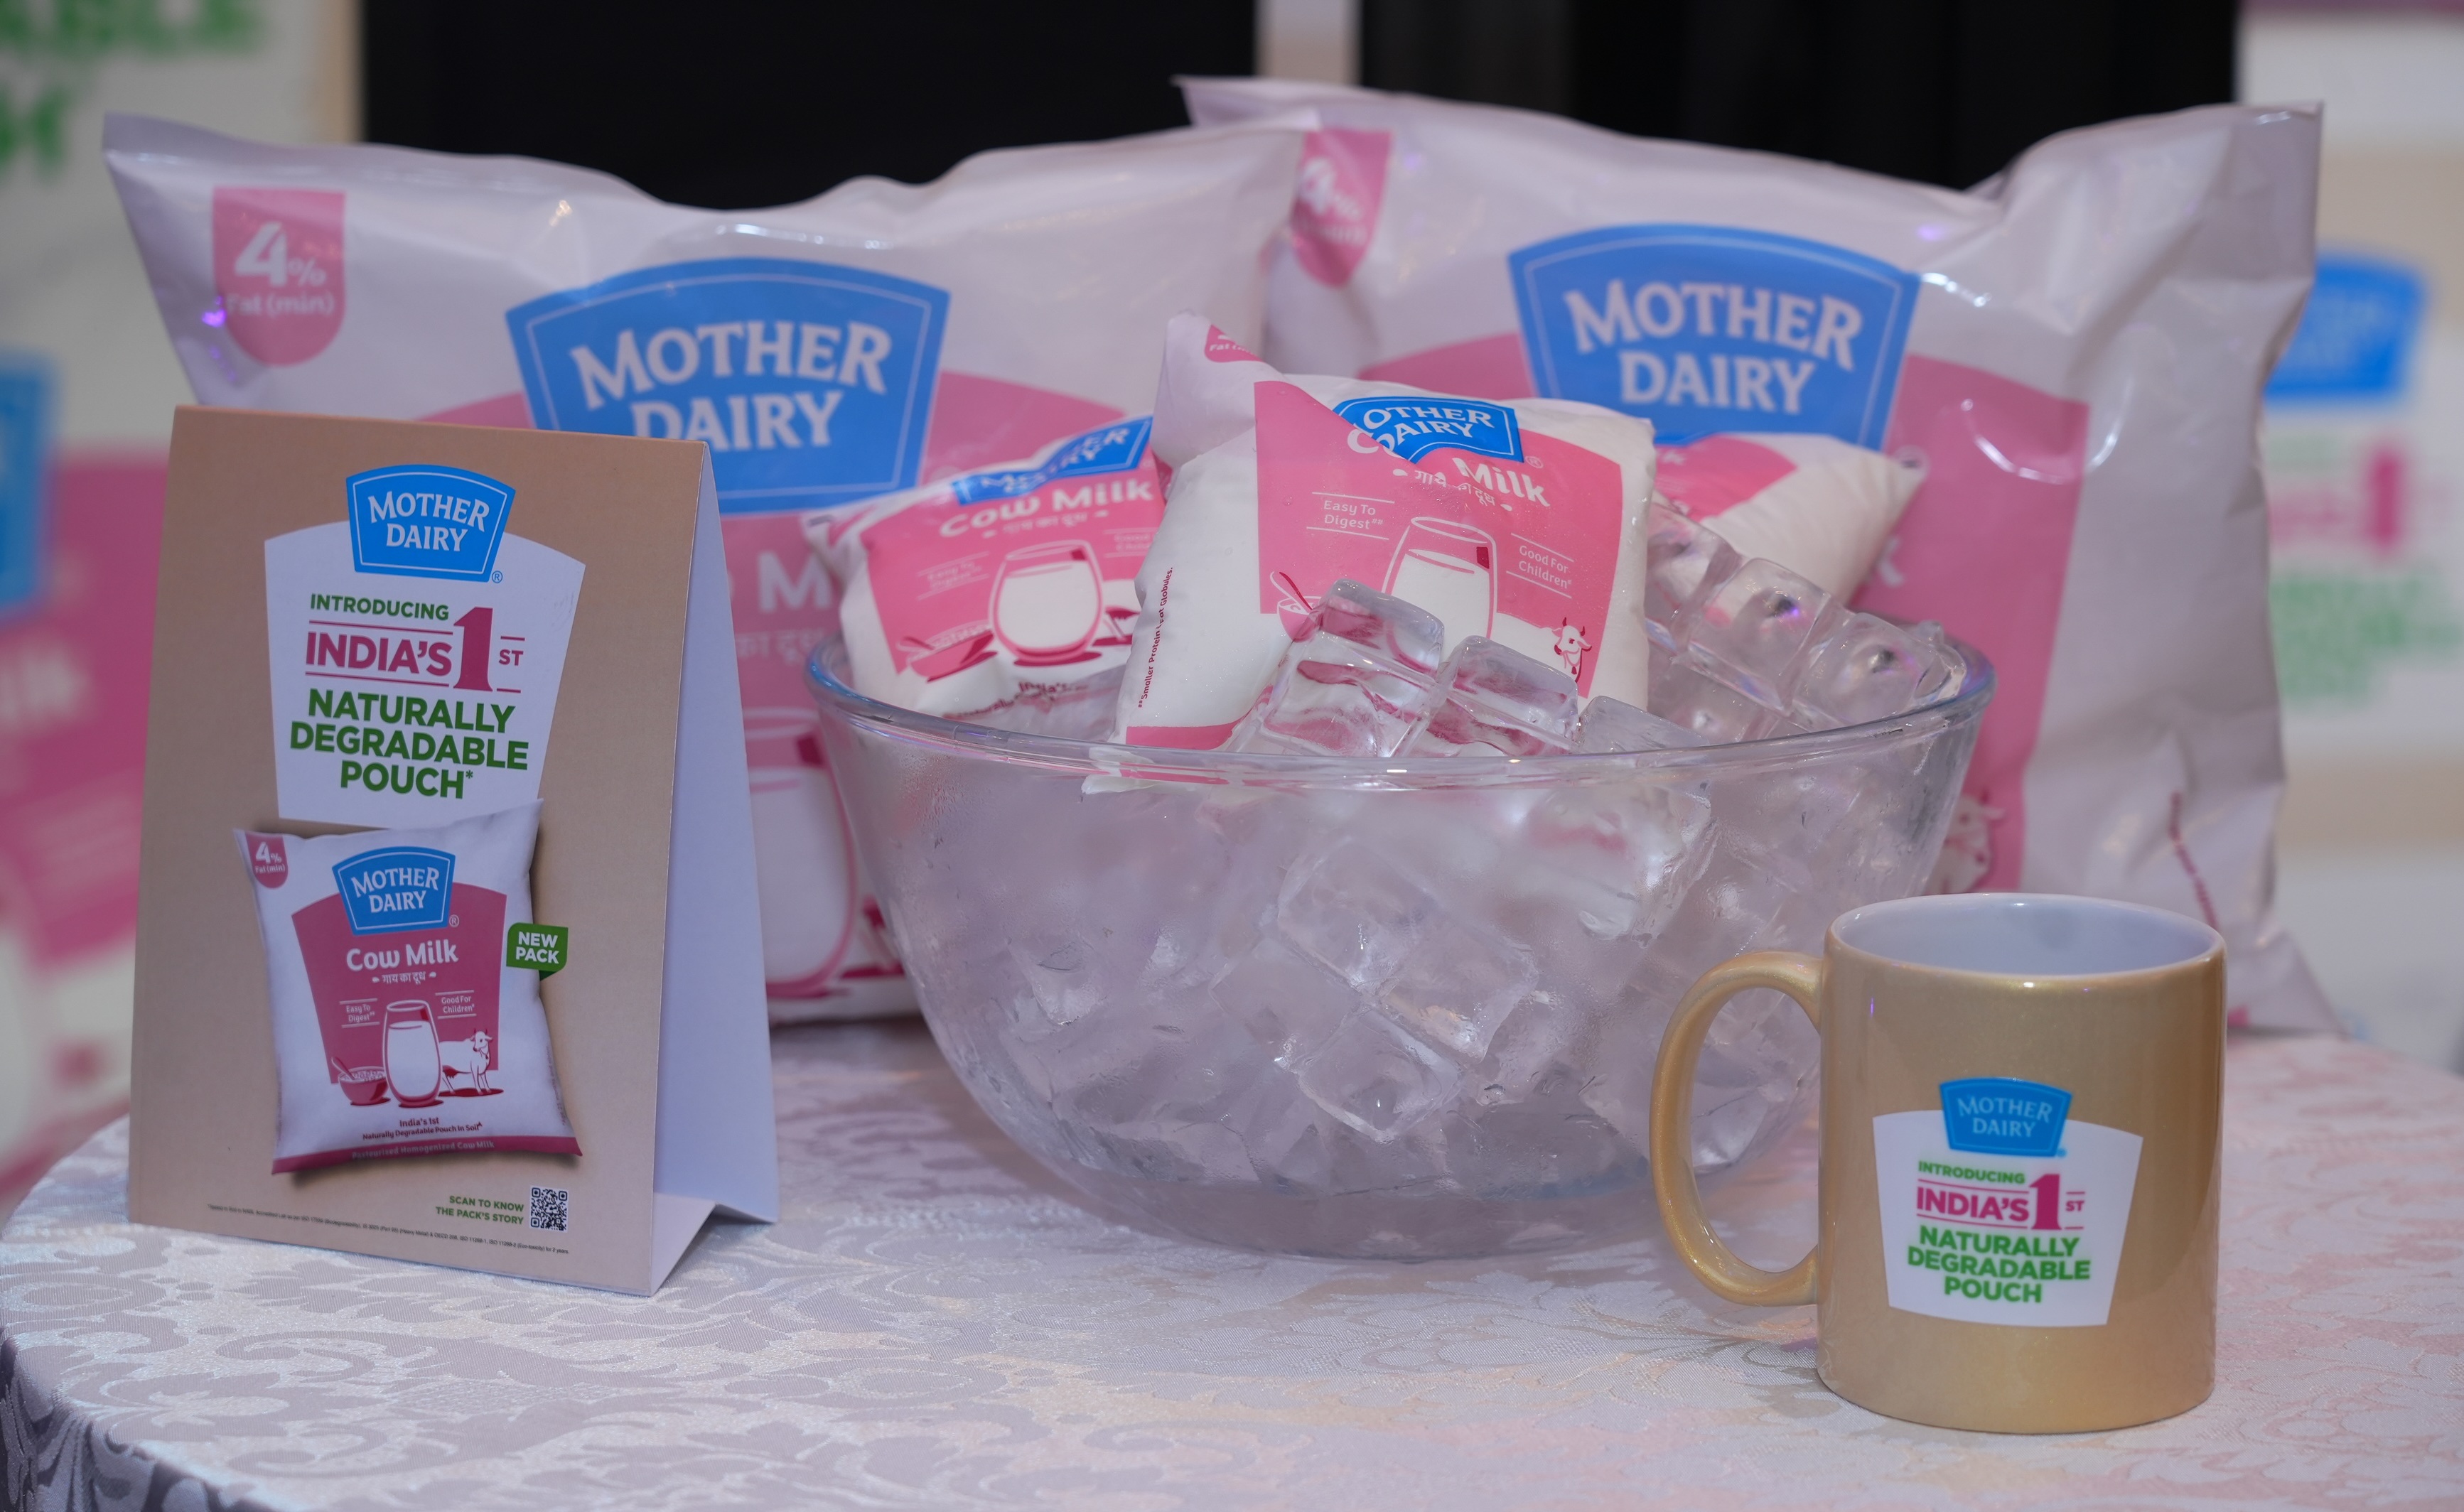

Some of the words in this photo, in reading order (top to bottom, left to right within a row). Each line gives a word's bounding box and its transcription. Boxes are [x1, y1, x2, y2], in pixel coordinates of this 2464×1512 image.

[234, 222, 327, 287] 4%
[267, 290, 335, 317] (min)
[1563, 278, 1862, 370] MOTHER
[570, 320, 893, 411] MOTHER
[1619, 350, 1815, 415] DAIRY
[631, 390, 844, 451] DAIRY
[1359, 406, 1495, 431] OTHER
[1452, 458, 1551, 507] Milk
[367, 491, 490, 532] MOTHER
[940, 497, 1040, 536] Cow
[1052, 480, 1153, 511] Milk
[1324, 500, 1357, 515] Easy
[1360, 504, 1376, 516] To
[386, 523, 468, 551] DAIRY
[1519, 545, 1549, 566] Good
[1551, 558, 1569, 574] For
[311, 593, 449, 620] INTRODUCING
[1148, 628, 1161, 663] Protein
[1160, 567, 1173, 606] Globules.
[306, 631, 453, 676] INDIA'S
[308, 688, 516, 733] NATURALLY
[290, 720, 529, 770] DEGRADABLE
[255, 841, 281, 864] 4%
[267, 864, 286, 874] (min)
[351, 866, 439, 897] MOTHER
[369, 890, 426, 913] DAIRY
[518, 931, 558, 949] NEW
[346, 948, 400, 971] Cow
[406, 939, 459, 966] Milk
[516, 946, 559, 964] PACK
[346, 1005, 362, 1014] Easy
[399, 1118, 428, 1127] India's
[1957, 1096, 2053, 1123] MOTHER
[362, 1130, 394, 1140] Naturally
[395, 1128, 434, 1137] Degradable
[436, 1125, 458, 1133] Pouch
[1973, 1118, 2036, 1137] DAIRY
[1919, 1160, 2025, 1184] INTRODUCING
[436, 1206, 454, 1216] THE
[457, 1209, 490, 1220] PACK'S
[493, 1214, 524, 1224] STORY
[449, 1196, 475, 1206] SCAN
[478, 1199, 490, 1208] TO
[493, 1201, 524, 1212] KNOW
[1917, 1187, 2029, 1222] INDIA'S
[1920, 1225, 2080, 1257] NATURALLY
[1908, 1246, 2090, 1280] DEGRADABLE
[1944, 1276, 2042, 1303] POUCH
